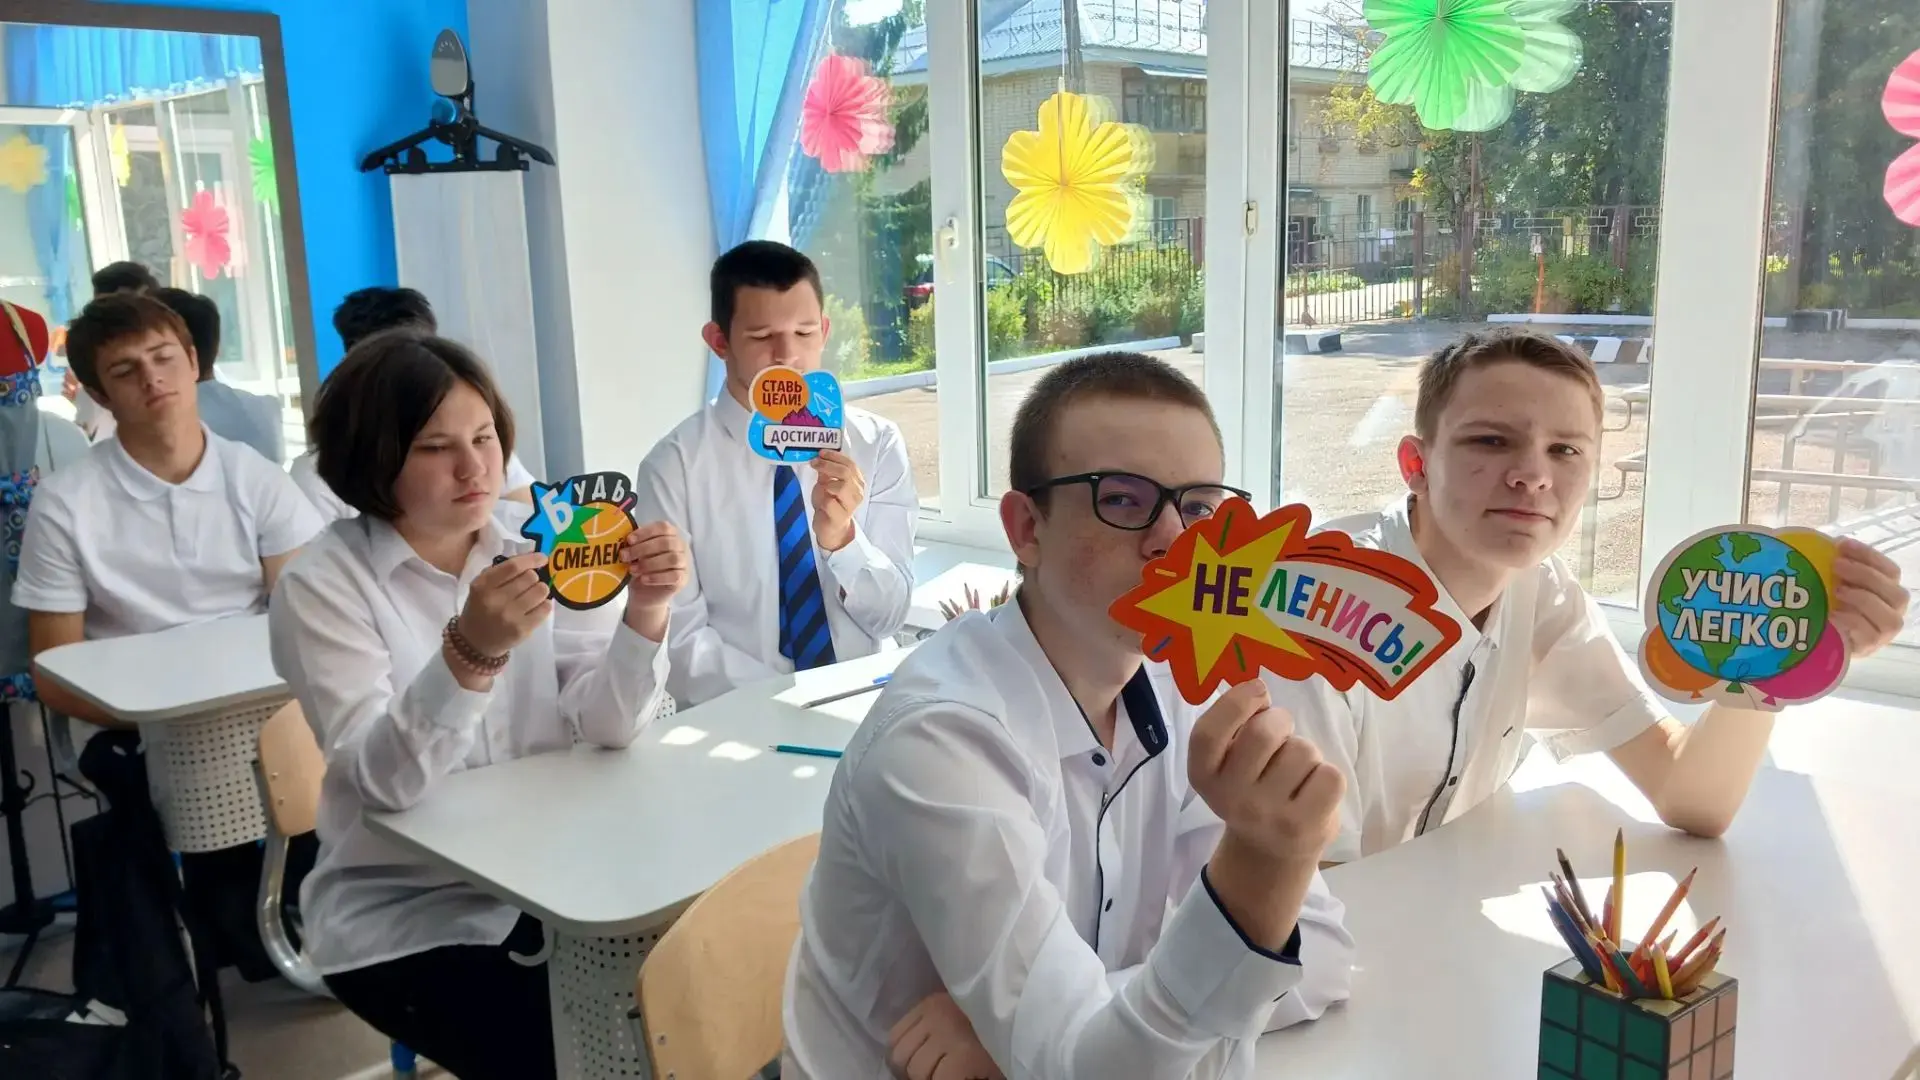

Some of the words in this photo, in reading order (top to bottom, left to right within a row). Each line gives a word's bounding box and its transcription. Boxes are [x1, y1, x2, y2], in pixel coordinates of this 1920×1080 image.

[762, 380, 803, 393] СТАВЬ
[762, 393, 802, 407] ЦЕЛИ!
[770, 430, 838, 444] ДОСТИГАЙ!
[541, 475, 625, 535] БУДЬ
[553, 538, 625, 571] СМЕЛЕЙ
[1681, 568, 1810, 610] УЧИСЬ
[1193, 564, 1253, 617] НЕ
[1260, 568, 1425, 676] ЛЕНИСЬ!
[1672, 608, 1809, 652] ЛЕГКО!
